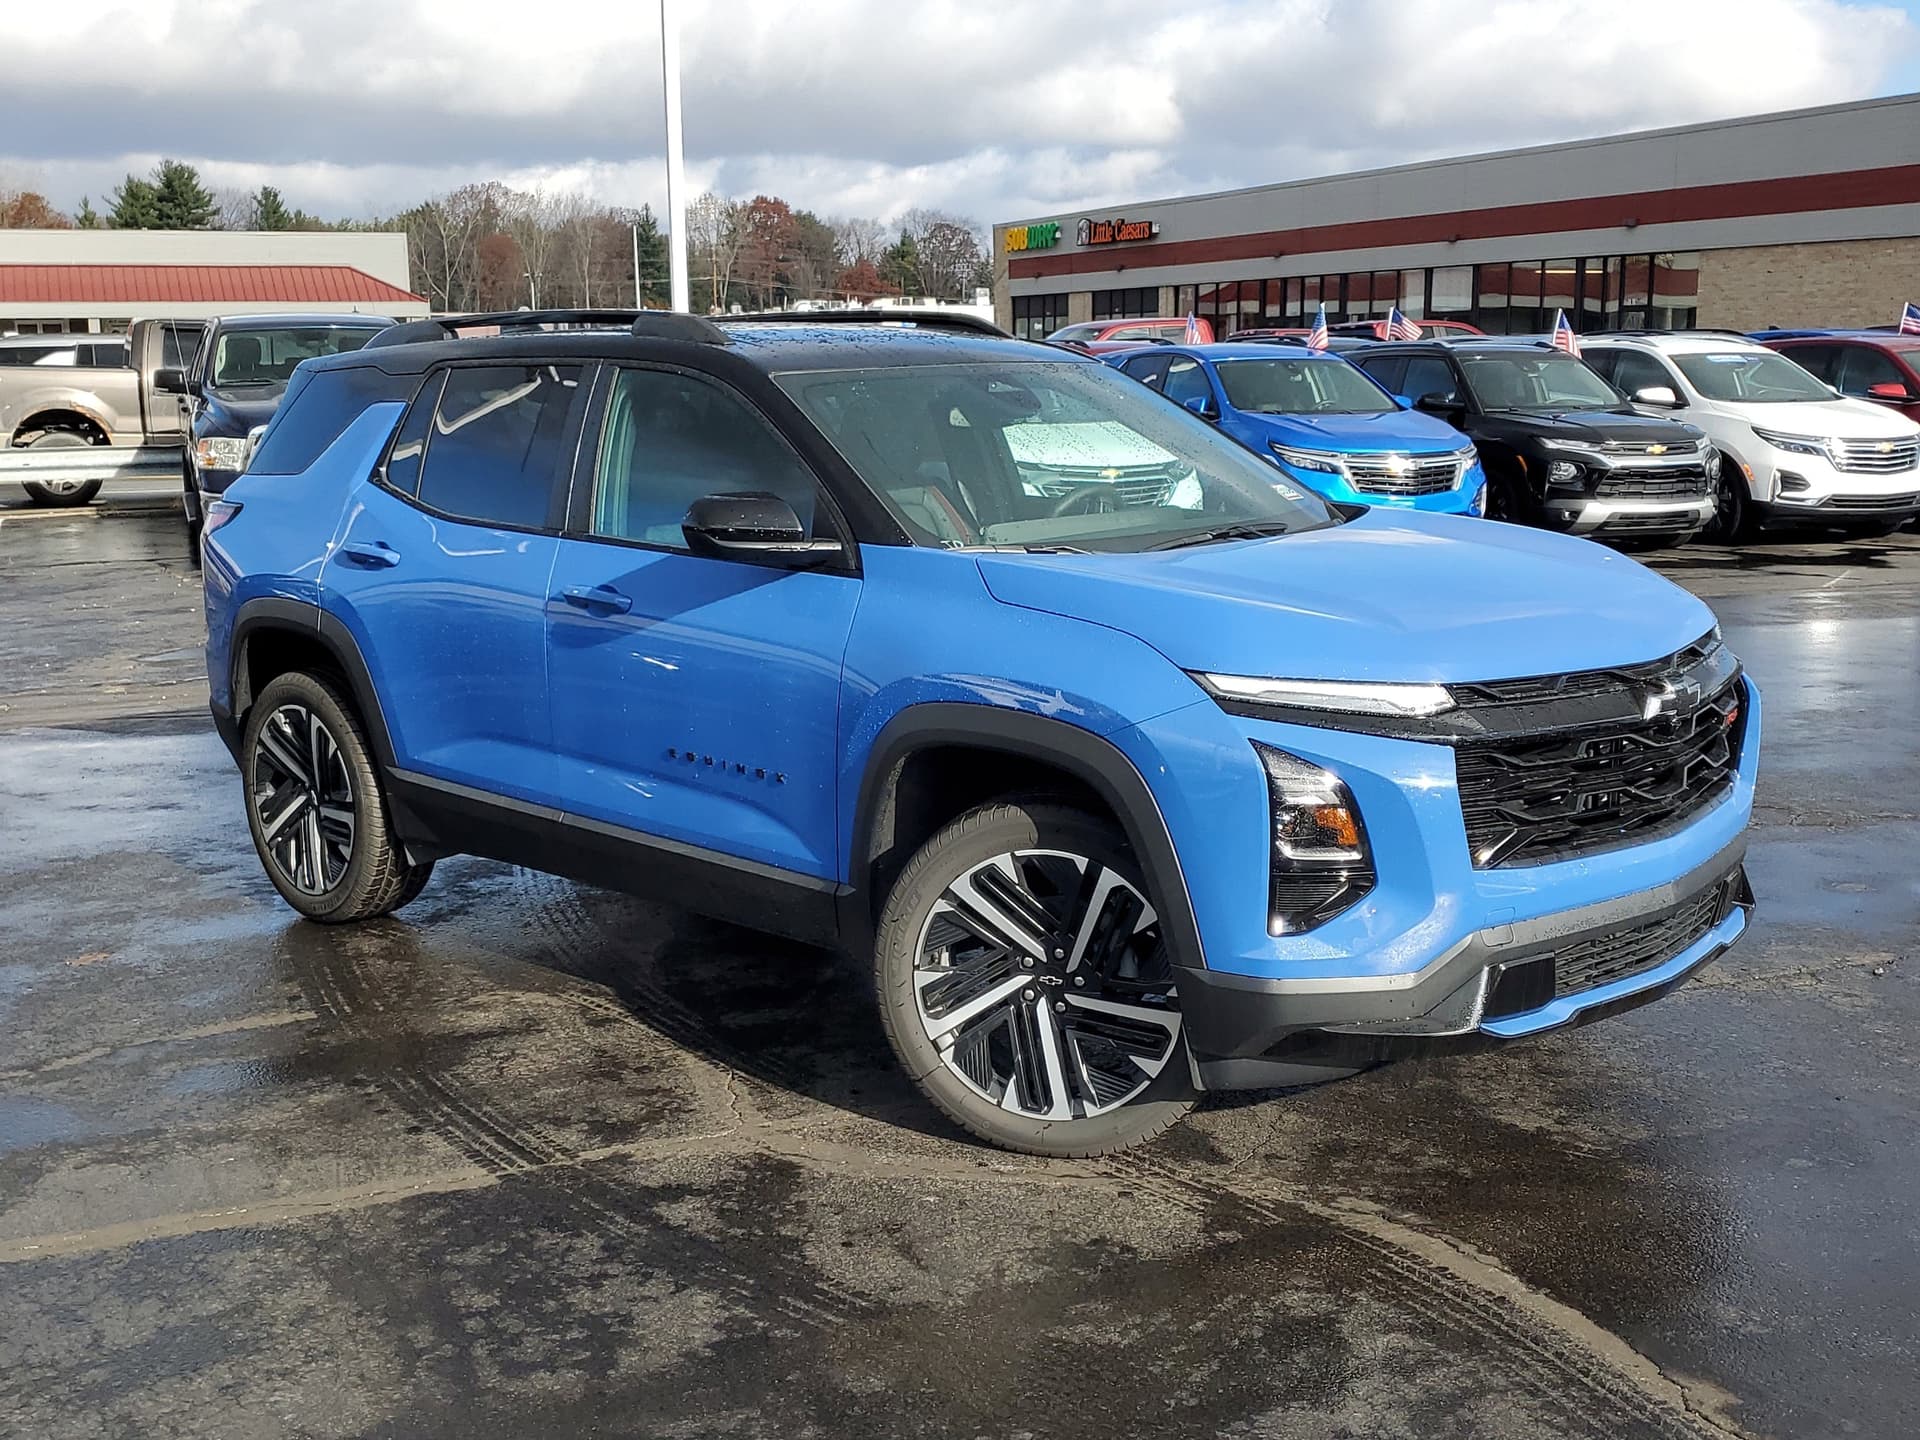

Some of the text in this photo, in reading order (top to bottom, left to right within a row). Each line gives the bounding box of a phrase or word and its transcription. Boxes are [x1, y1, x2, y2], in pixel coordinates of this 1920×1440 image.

[1005, 222, 1059, 253] SUBWAY
[1090, 218, 1150, 244] Little Caesars
